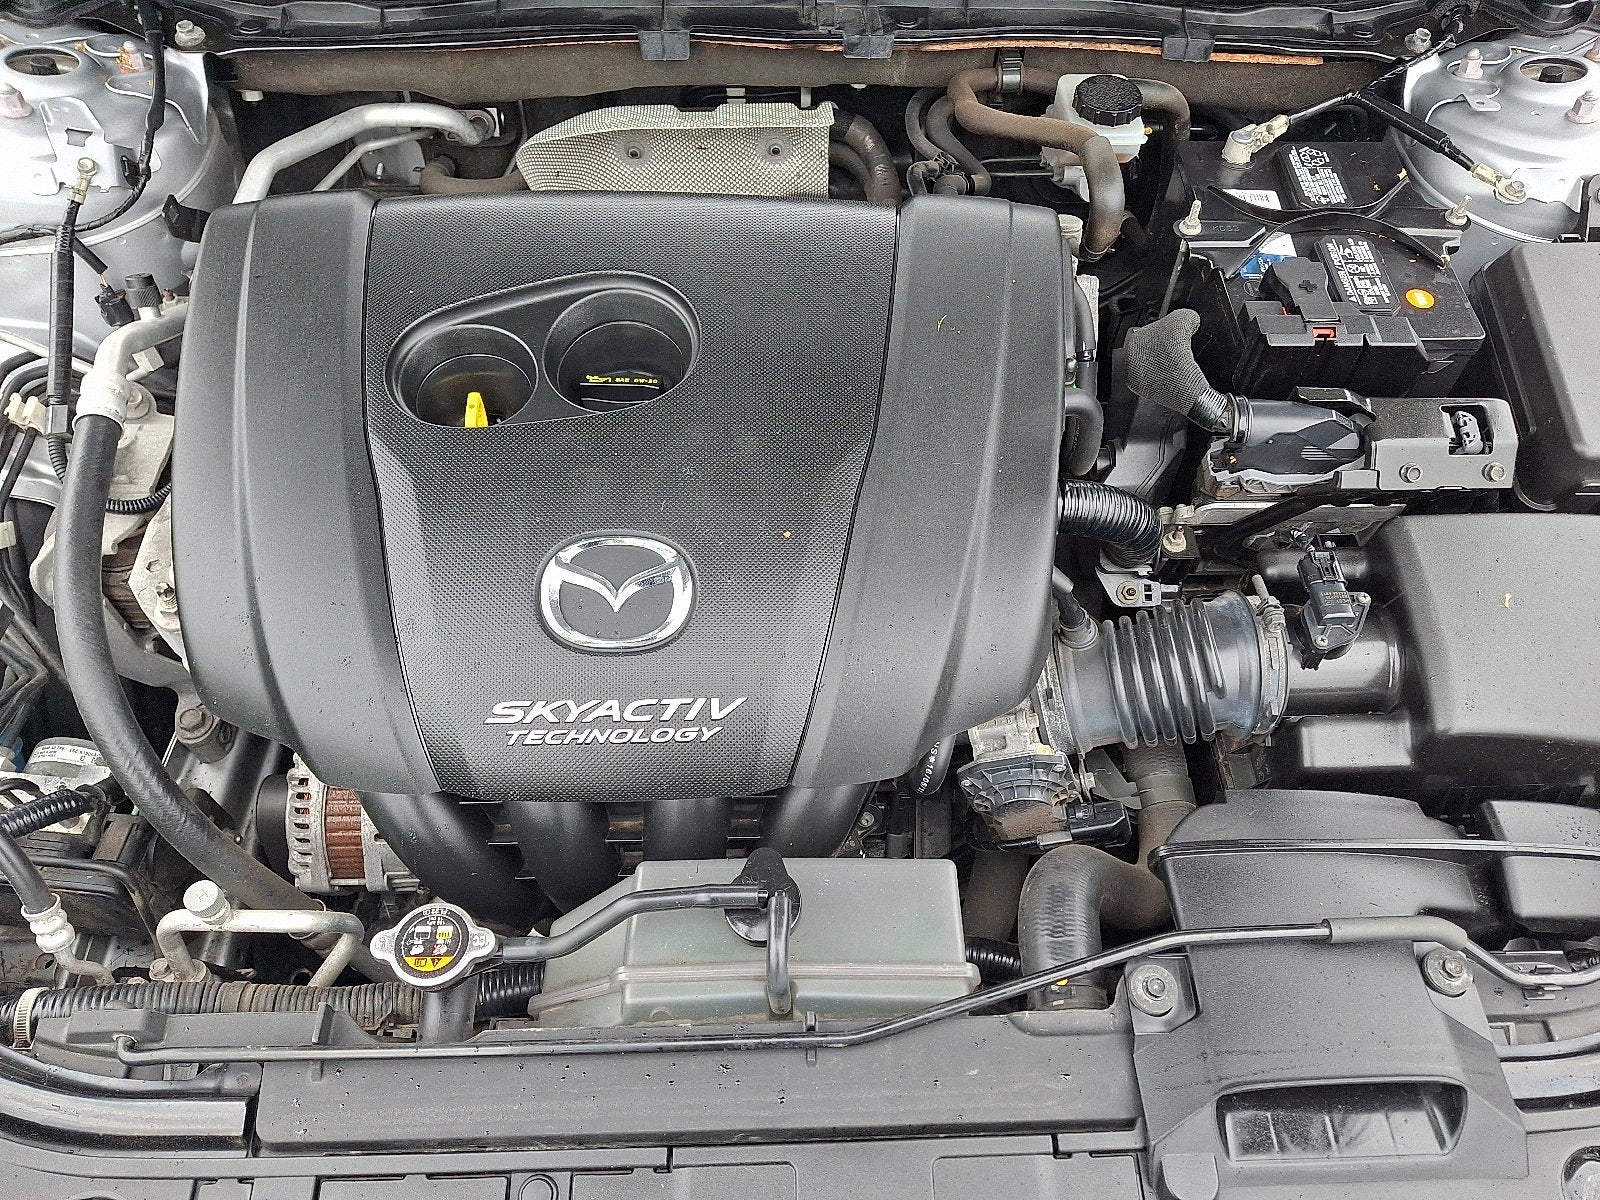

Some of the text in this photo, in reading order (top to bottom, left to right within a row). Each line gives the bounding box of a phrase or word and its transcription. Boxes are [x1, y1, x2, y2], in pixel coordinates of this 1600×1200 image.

[1325, 242, 1342, 266] POISON
[1337, 270, 1355, 296] DANGER
[483, 697, 748, 724] SKYACTIV
[506, 726, 724, 746] TECHNOLOGY
